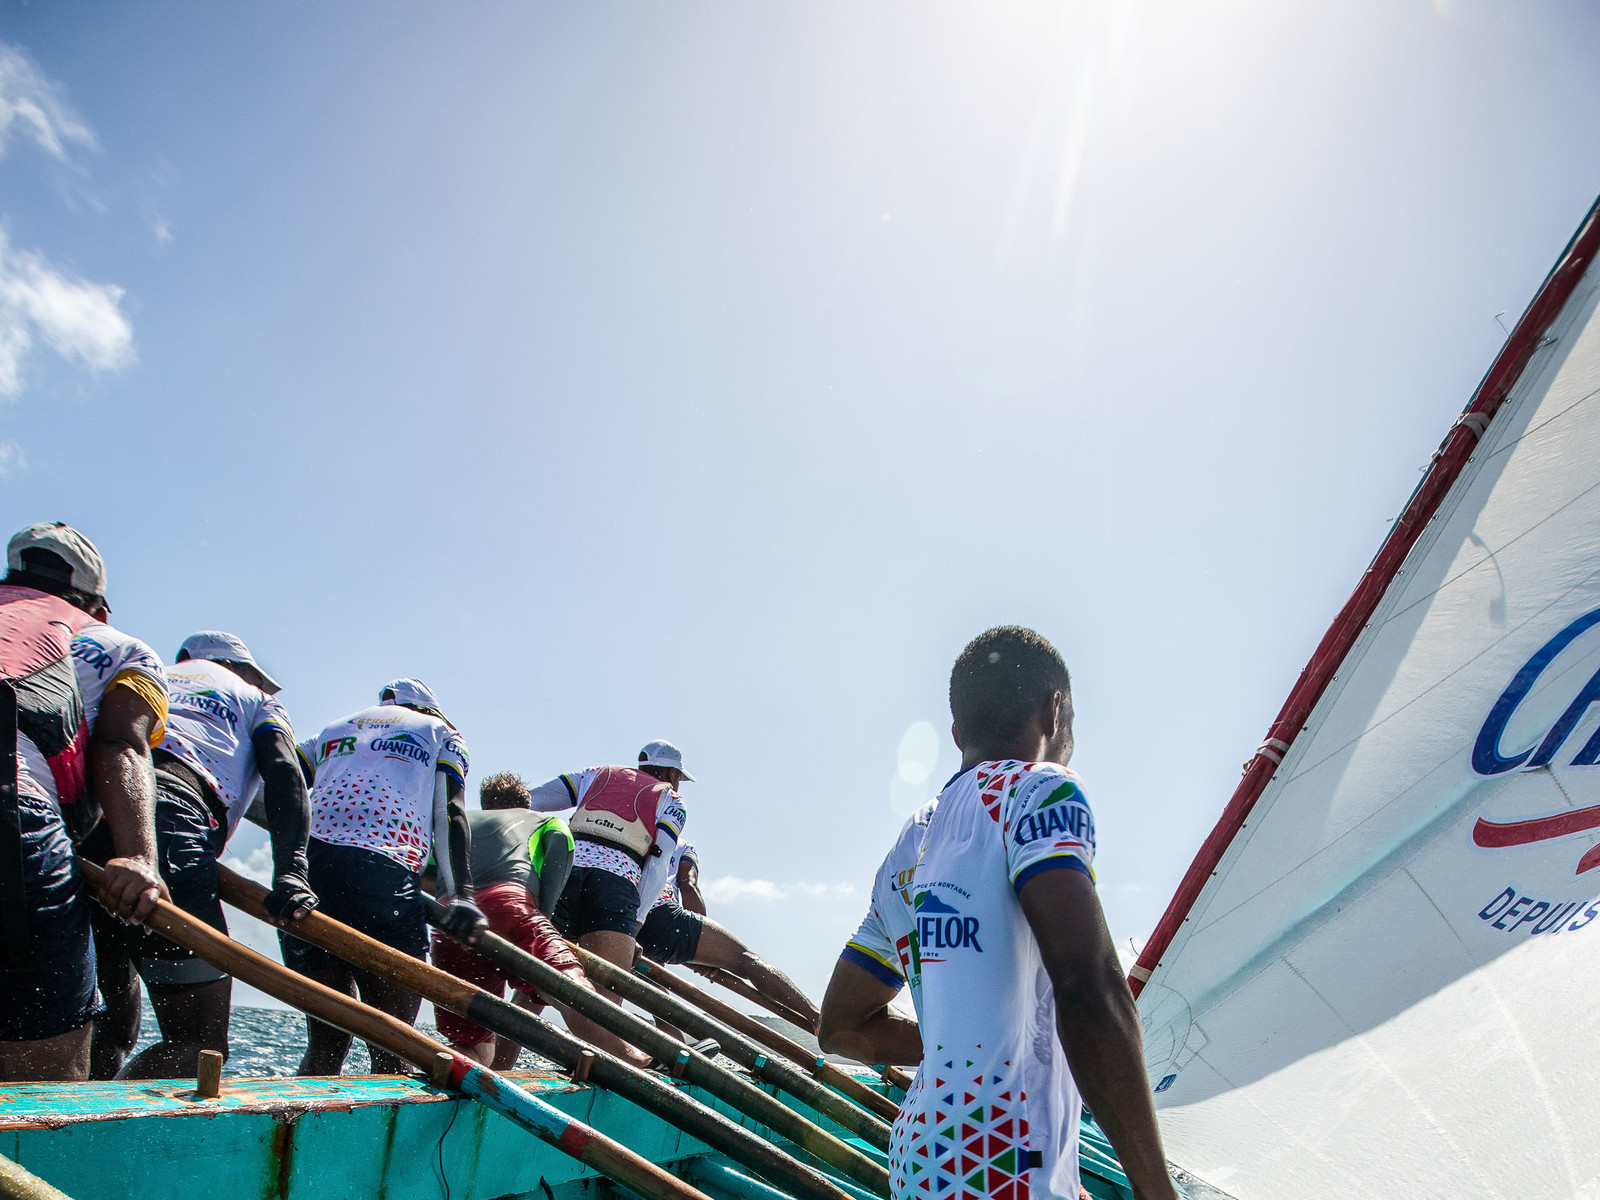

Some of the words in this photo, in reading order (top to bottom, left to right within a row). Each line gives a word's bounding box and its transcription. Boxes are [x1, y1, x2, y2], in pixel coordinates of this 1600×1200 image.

[370, 738, 430, 767] CHANFLOR
[1021, 795, 1031, 808] EAU
[1030, 784, 1039, 794] DE
[594, 818, 615, 829] Gill
[937, 881, 972, 900] MONTAGNE
[1478, 886, 1600, 935] DEPUIS
